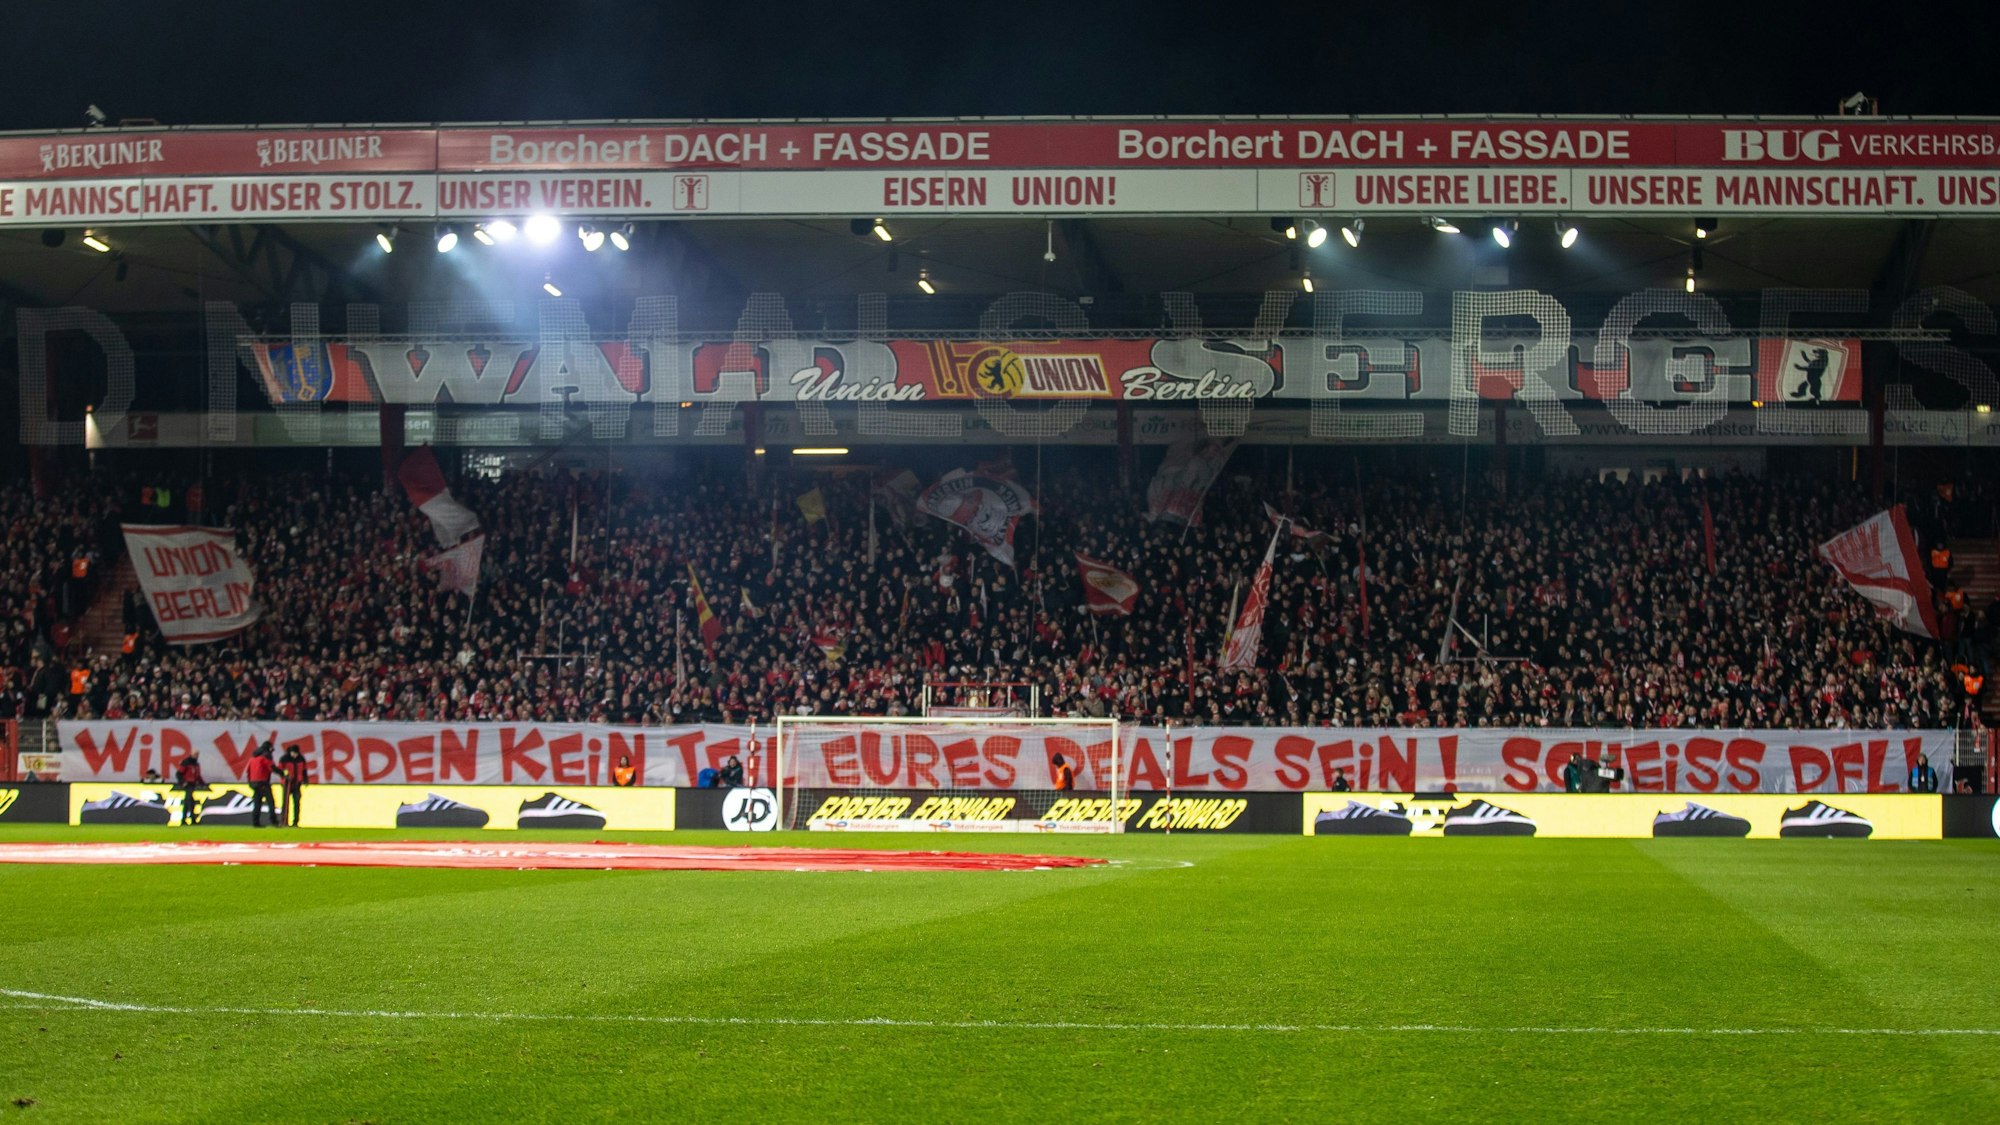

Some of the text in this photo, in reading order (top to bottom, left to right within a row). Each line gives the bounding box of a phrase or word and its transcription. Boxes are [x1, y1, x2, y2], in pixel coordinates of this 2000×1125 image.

[56, 139, 165, 169] BERLINER
[274, 136, 383, 165] BERLINER
[490, 132, 990, 164] Borchert DACH + FASSADE
[1118, 130, 1630, 159] Borchert DACH + FASSADE
[1721, 129, 2000, 161] BUG VERKEHRSB
[25, 183, 219, 215] MANNSCHAFT.
[230, 182, 325, 212] UNSER
[330, 181, 422, 211] STOLZ.
[440, 179, 531, 209] UNSER
[542, 178, 652, 209] VEREIN.
[883, 176, 1117, 206] EISERN UNION!
[1355, 175, 2000, 207] UNSERE LIEBE. UNSERE MANNSCHAFT. UNS
[791, 366, 926, 401] Union
[1024, 358, 1107, 392] UNION
[1120, 367, 1257, 401] Berlin
[144, 540, 232, 577] UNION
[152, 581, 250, 623] BERLIN
[820, 732, 1021, 788] EURES
[1044, 736, 1254, 790] DEALS
[731, 798, 769, 823] JD
[806, 796, 1016, 825] FOREVER FORWARD
[1040, 798, 1247, 829] FOREVER FORWARD
